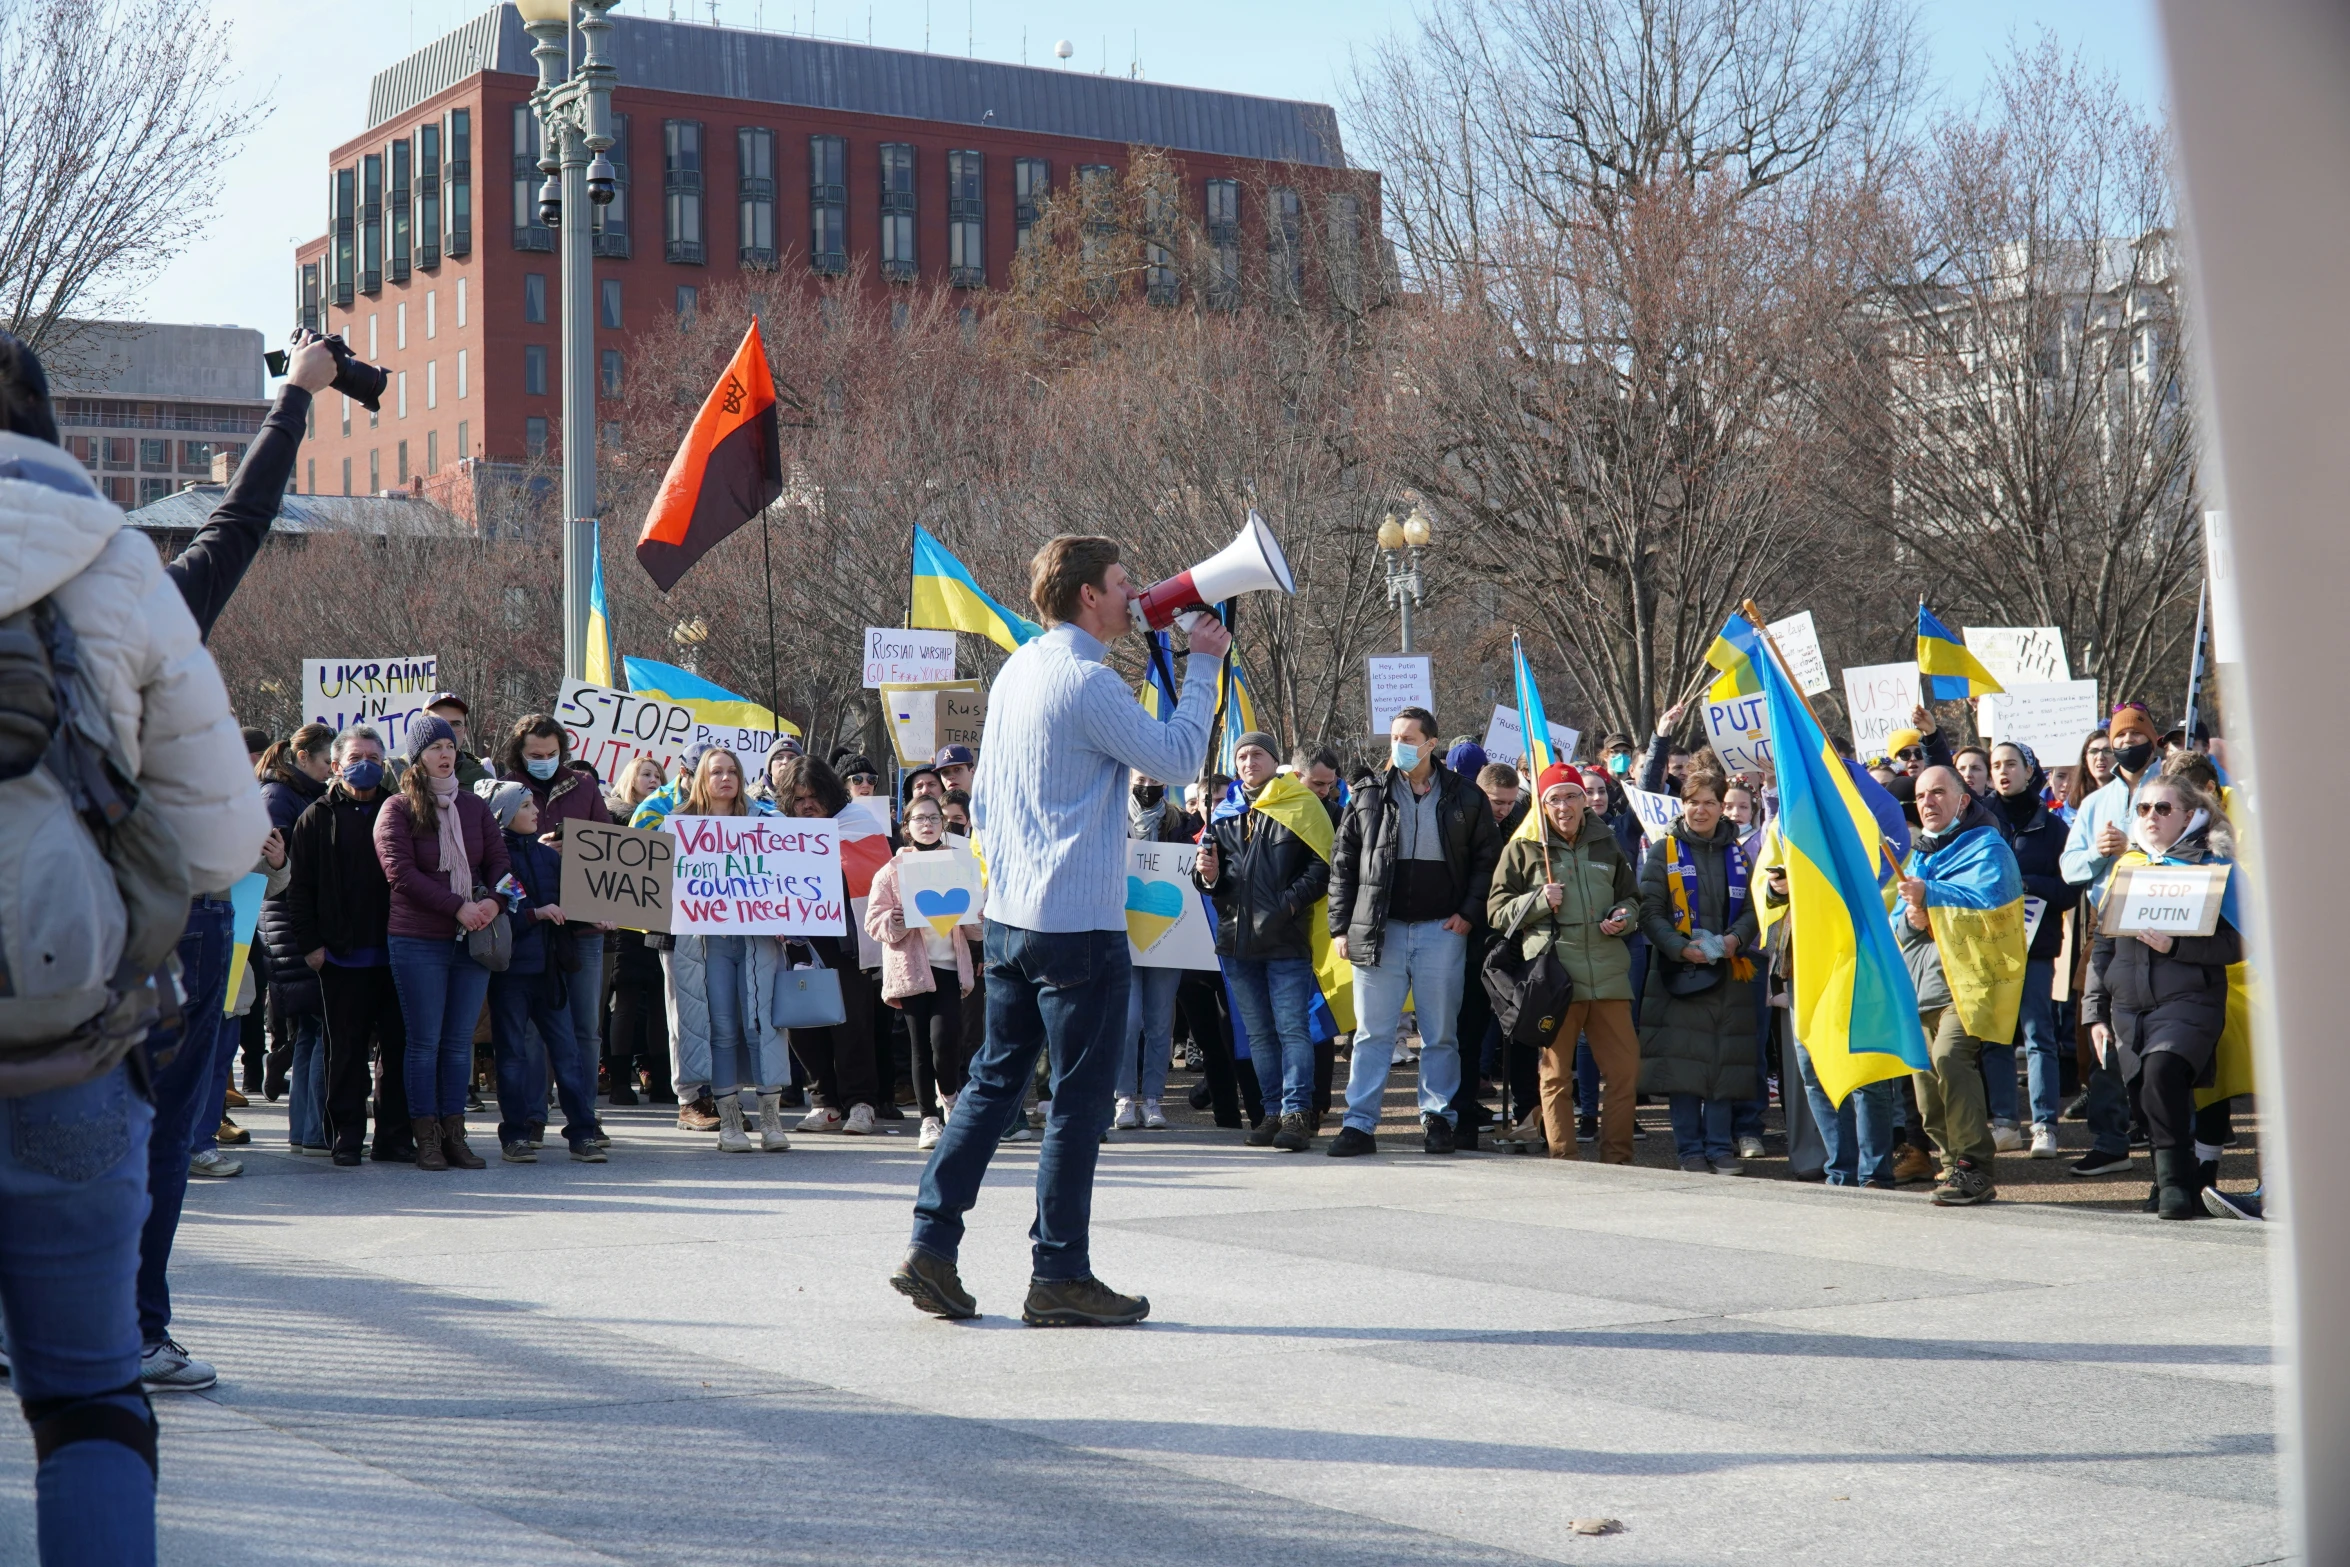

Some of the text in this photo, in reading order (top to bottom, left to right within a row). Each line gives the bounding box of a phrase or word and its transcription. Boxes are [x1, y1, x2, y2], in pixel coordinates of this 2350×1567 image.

[867, 663, 884, 682] GO
[1378, 663, 1394, 671] Hey,
[1853, 678, 1910, 713] USA
[563, 688, 691, 746] STOP
[1709, 697, 1767, 736] PUT
[1854, 717, 1915, 740] UKRAIN
[696, 724, 731, 749] Pres
[736, 728, 797, 754] BID
[944, 728, 983, 743] TERR
[565, 728, 671, 783] PUT
[943, 748, 954, 761] A
[1485, 748, 1497, 759] Go
[575, 829, 671, 871] STOP
[674, 818, 830, 857] Volunteers
[673, 854, 719, 880] from
[1136, 853, 1160, 872] THE
[584, 867, 662, 910] WAR
[687, 872, 823, 902] countries
[2147, 884, 2192, 898] STOP
[737, 896, 792, 923] need
[797, 898, 843, 926] you
[2138, 907, 2190, 921] PUTIN
